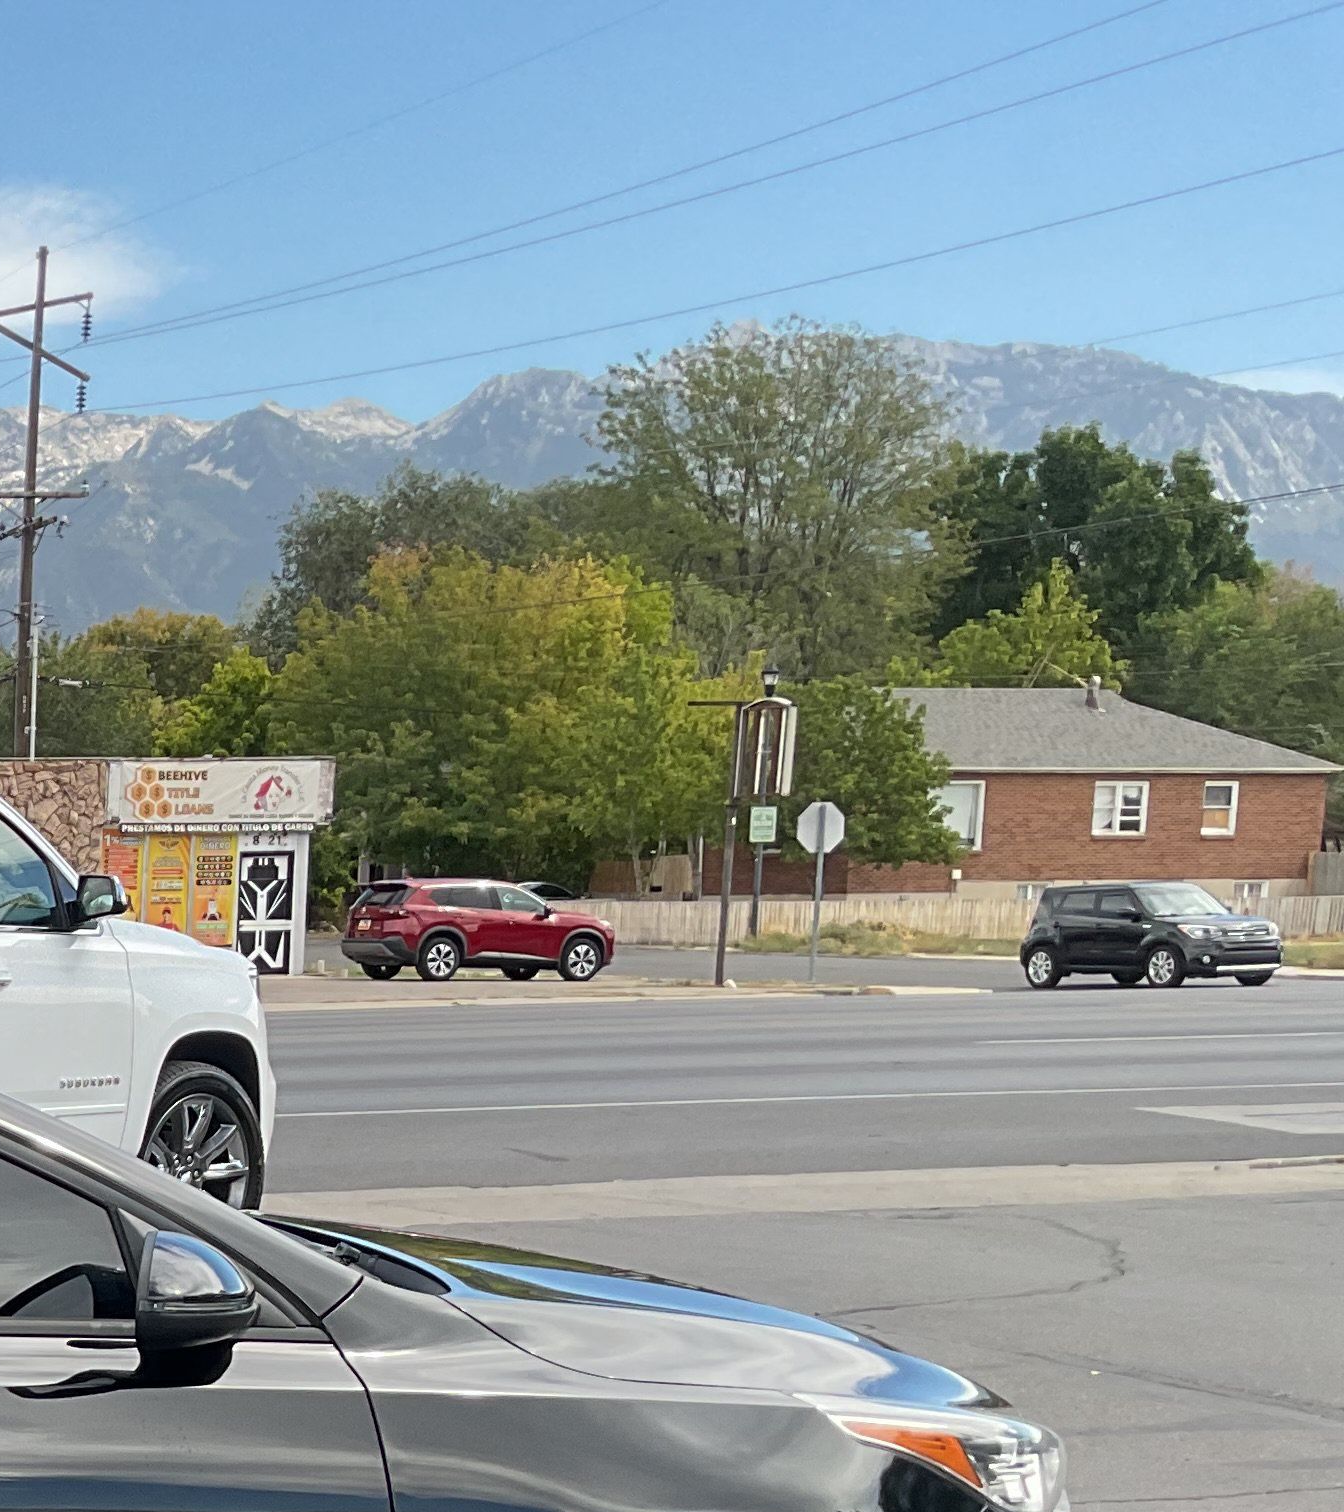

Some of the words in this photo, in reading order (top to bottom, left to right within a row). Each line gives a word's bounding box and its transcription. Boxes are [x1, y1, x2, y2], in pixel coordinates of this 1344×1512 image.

[158, 770, 208, 781] BEEHIVE
[167, 786, 200, 799] TITLE
[174, 803, 214, 816] LOANS
[121, 823, 173, 833] PRESTAMOS
[174, 823, 186, 833] DE
[187, 823, 220, 833] DINERO
[221, 823, 240, 832] CON
[271, 823, 284, 832] DE
[284, 823, 314, 832] CARRO
